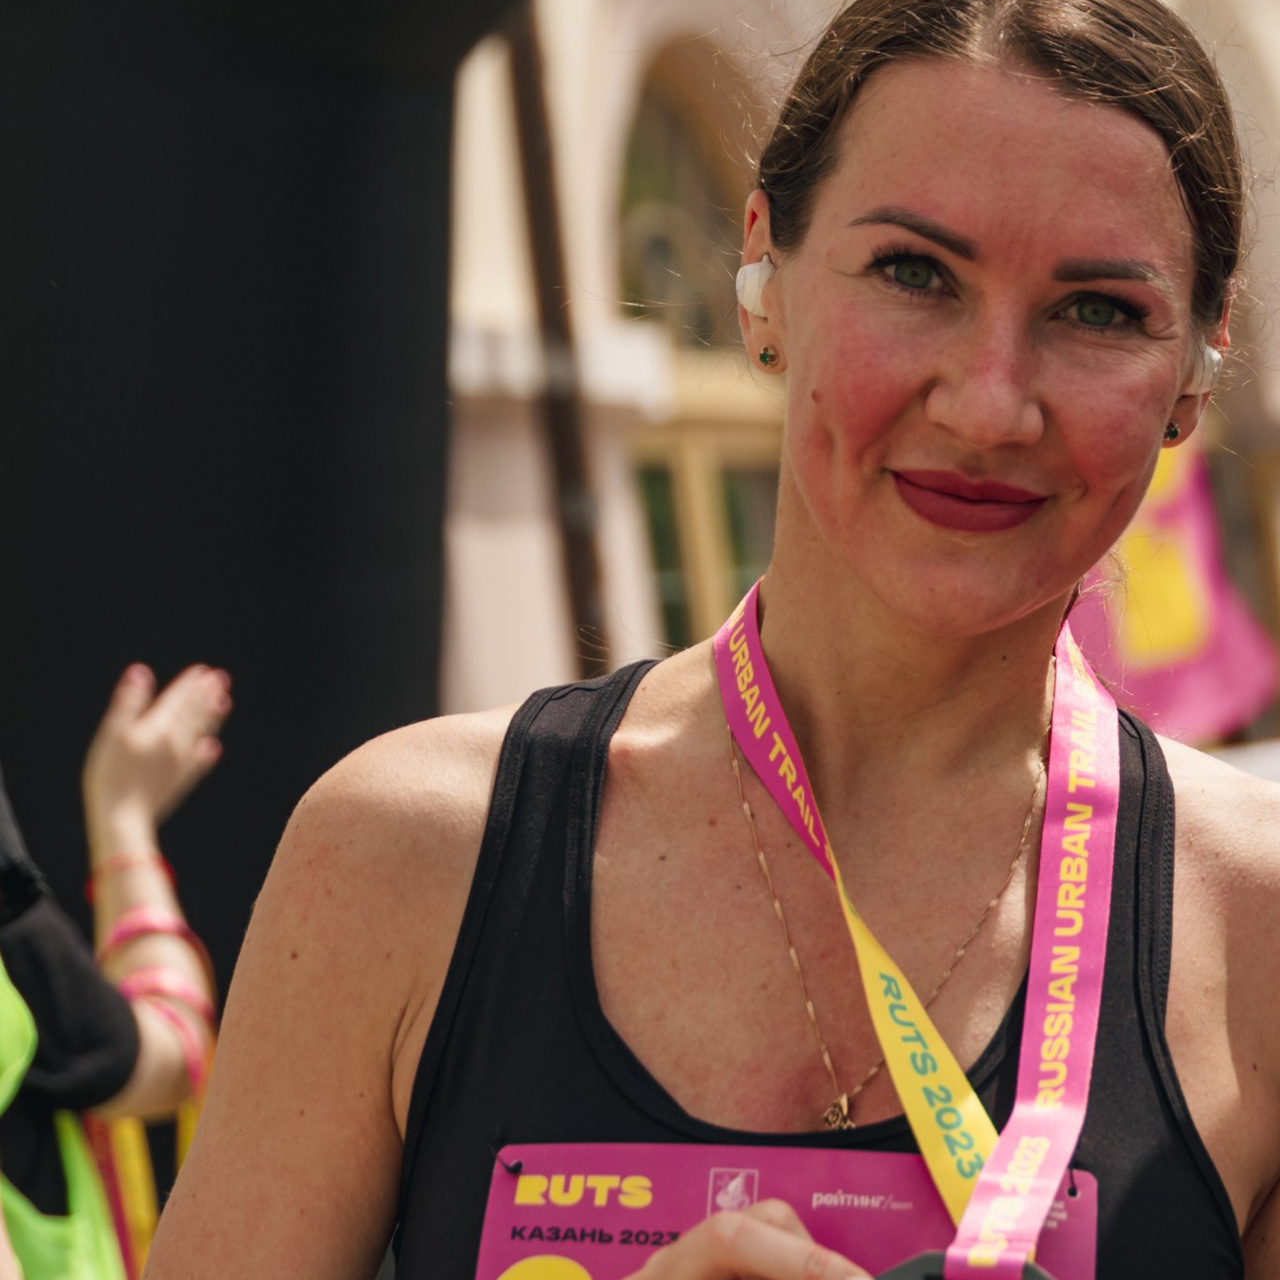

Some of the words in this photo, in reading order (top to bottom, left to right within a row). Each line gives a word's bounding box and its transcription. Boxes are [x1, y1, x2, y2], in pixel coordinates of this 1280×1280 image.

[729, 622, 771, 739] URBAN
[769, 731, 820, 847] TRAIL
[1068, 707, 1097, 793] TRAIL
[1054, 802, 1093, 937] URBAN
[879, 972, 939, 1077] RUTS
[921, 1085, 985, 1179] 2023
[1034, 946, 1080, 1111] RUSSIAN
[511, 1226, 613, 1243] КАЗАНЬ
[514, 1174, 653, 1208] RUTS
